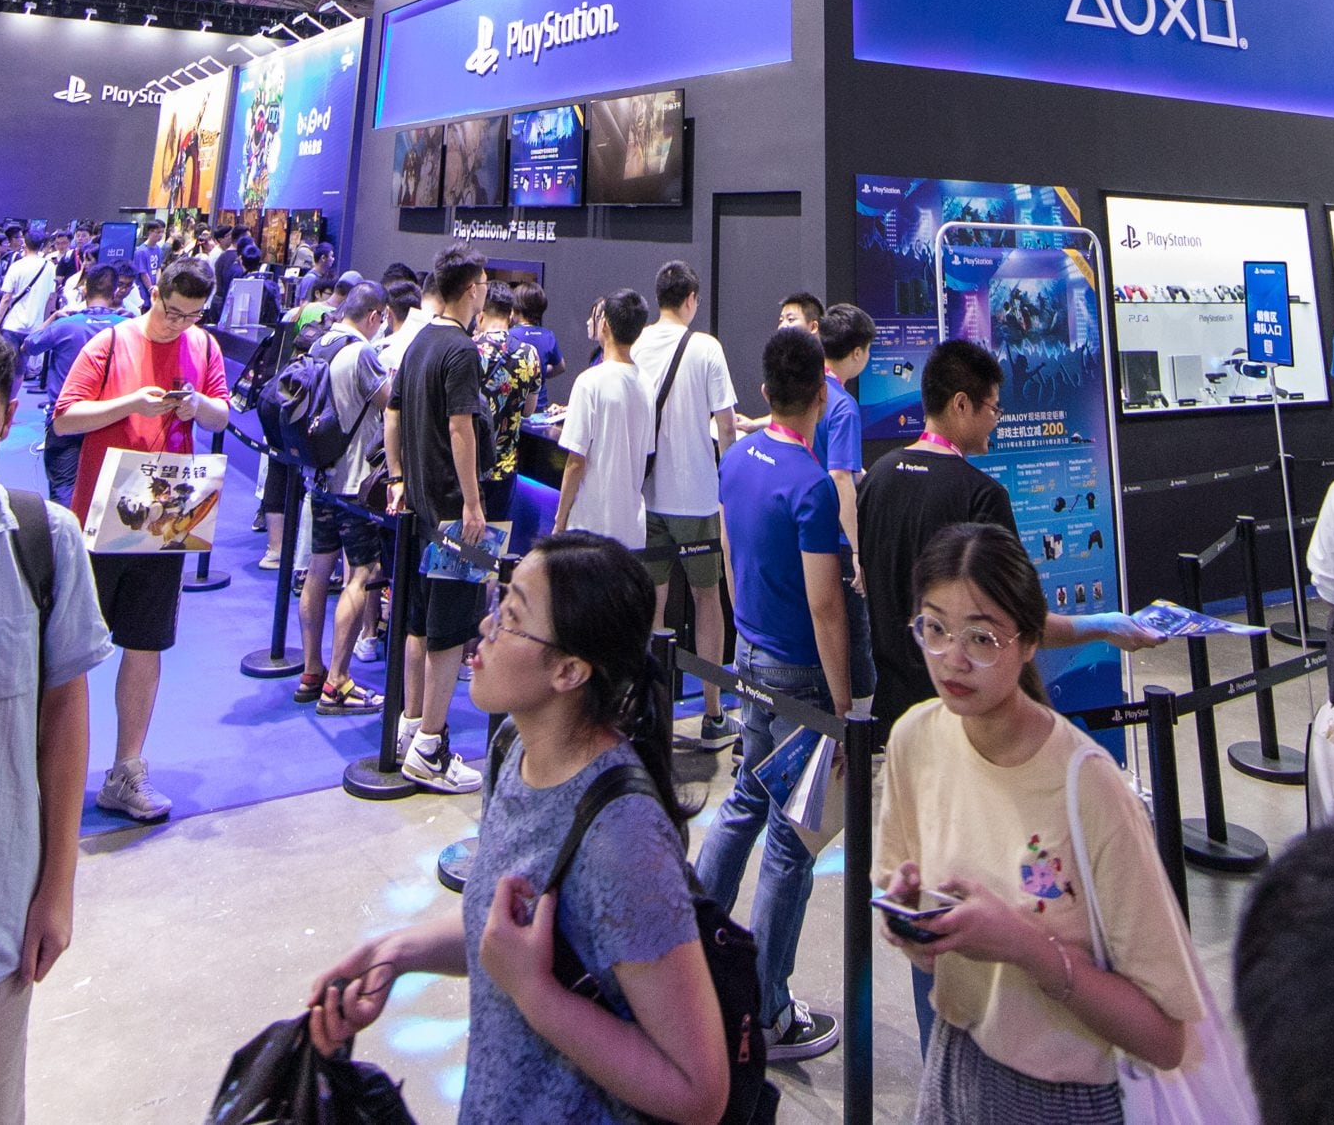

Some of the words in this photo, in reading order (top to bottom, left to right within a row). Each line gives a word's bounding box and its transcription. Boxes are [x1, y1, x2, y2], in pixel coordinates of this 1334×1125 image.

[1147, 231, 1202, 250] PlayStation
[963, 257, 994, 267] PlayStation
[1128, 314, 1149, 323] PS4
[1253, 322, 1282, 336] 排队入口
[1042, 422, 1064, 436] 200
[140, 461, 207, 479] 守望先锋
